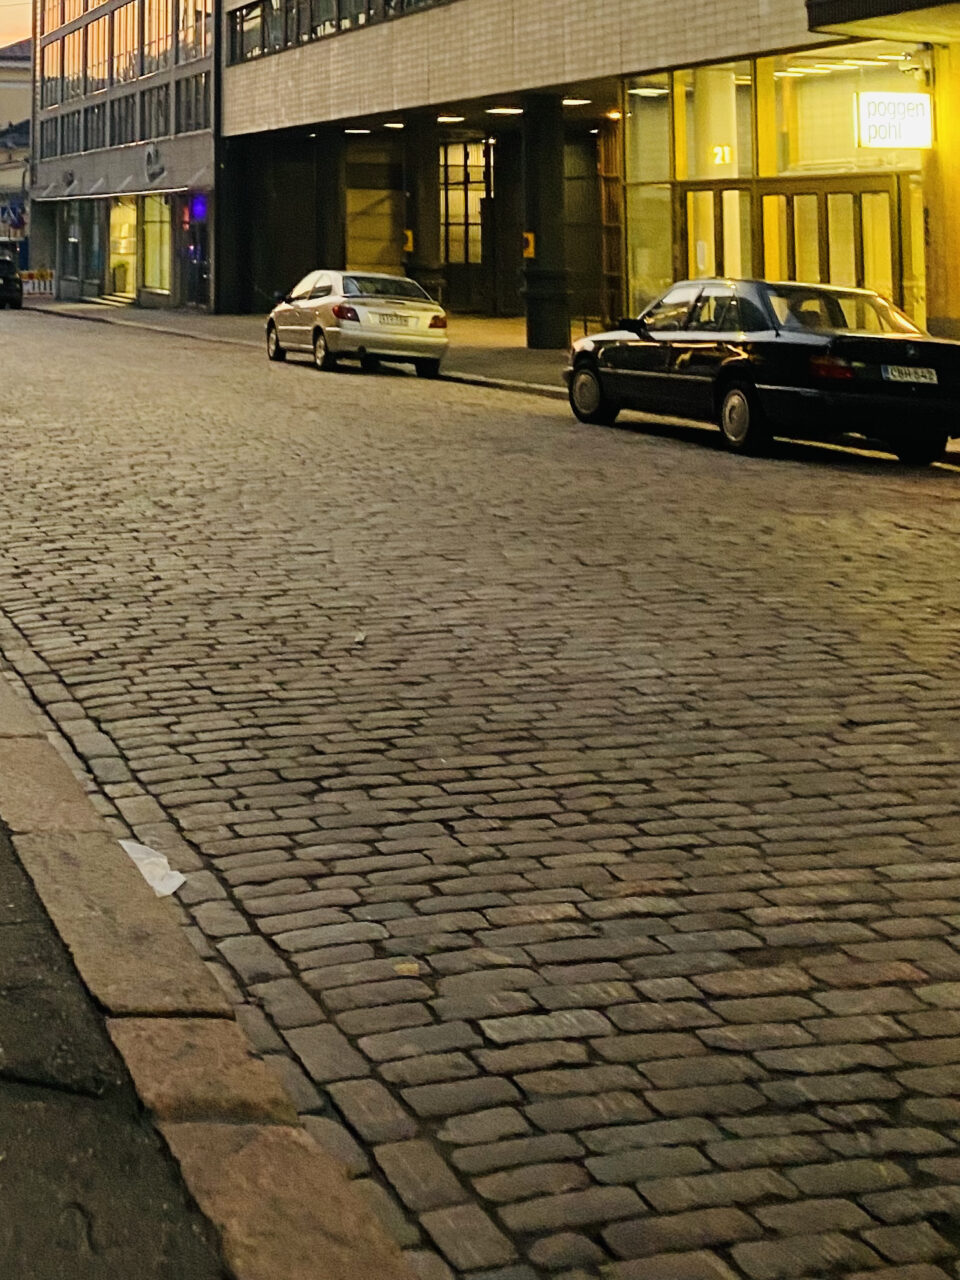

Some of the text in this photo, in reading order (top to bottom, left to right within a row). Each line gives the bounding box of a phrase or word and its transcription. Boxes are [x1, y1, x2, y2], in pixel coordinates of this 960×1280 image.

[867, 101, 925, 120] poggen
[867, 121, 902, 143] pohl
[713, 146, 731, 164] 21
